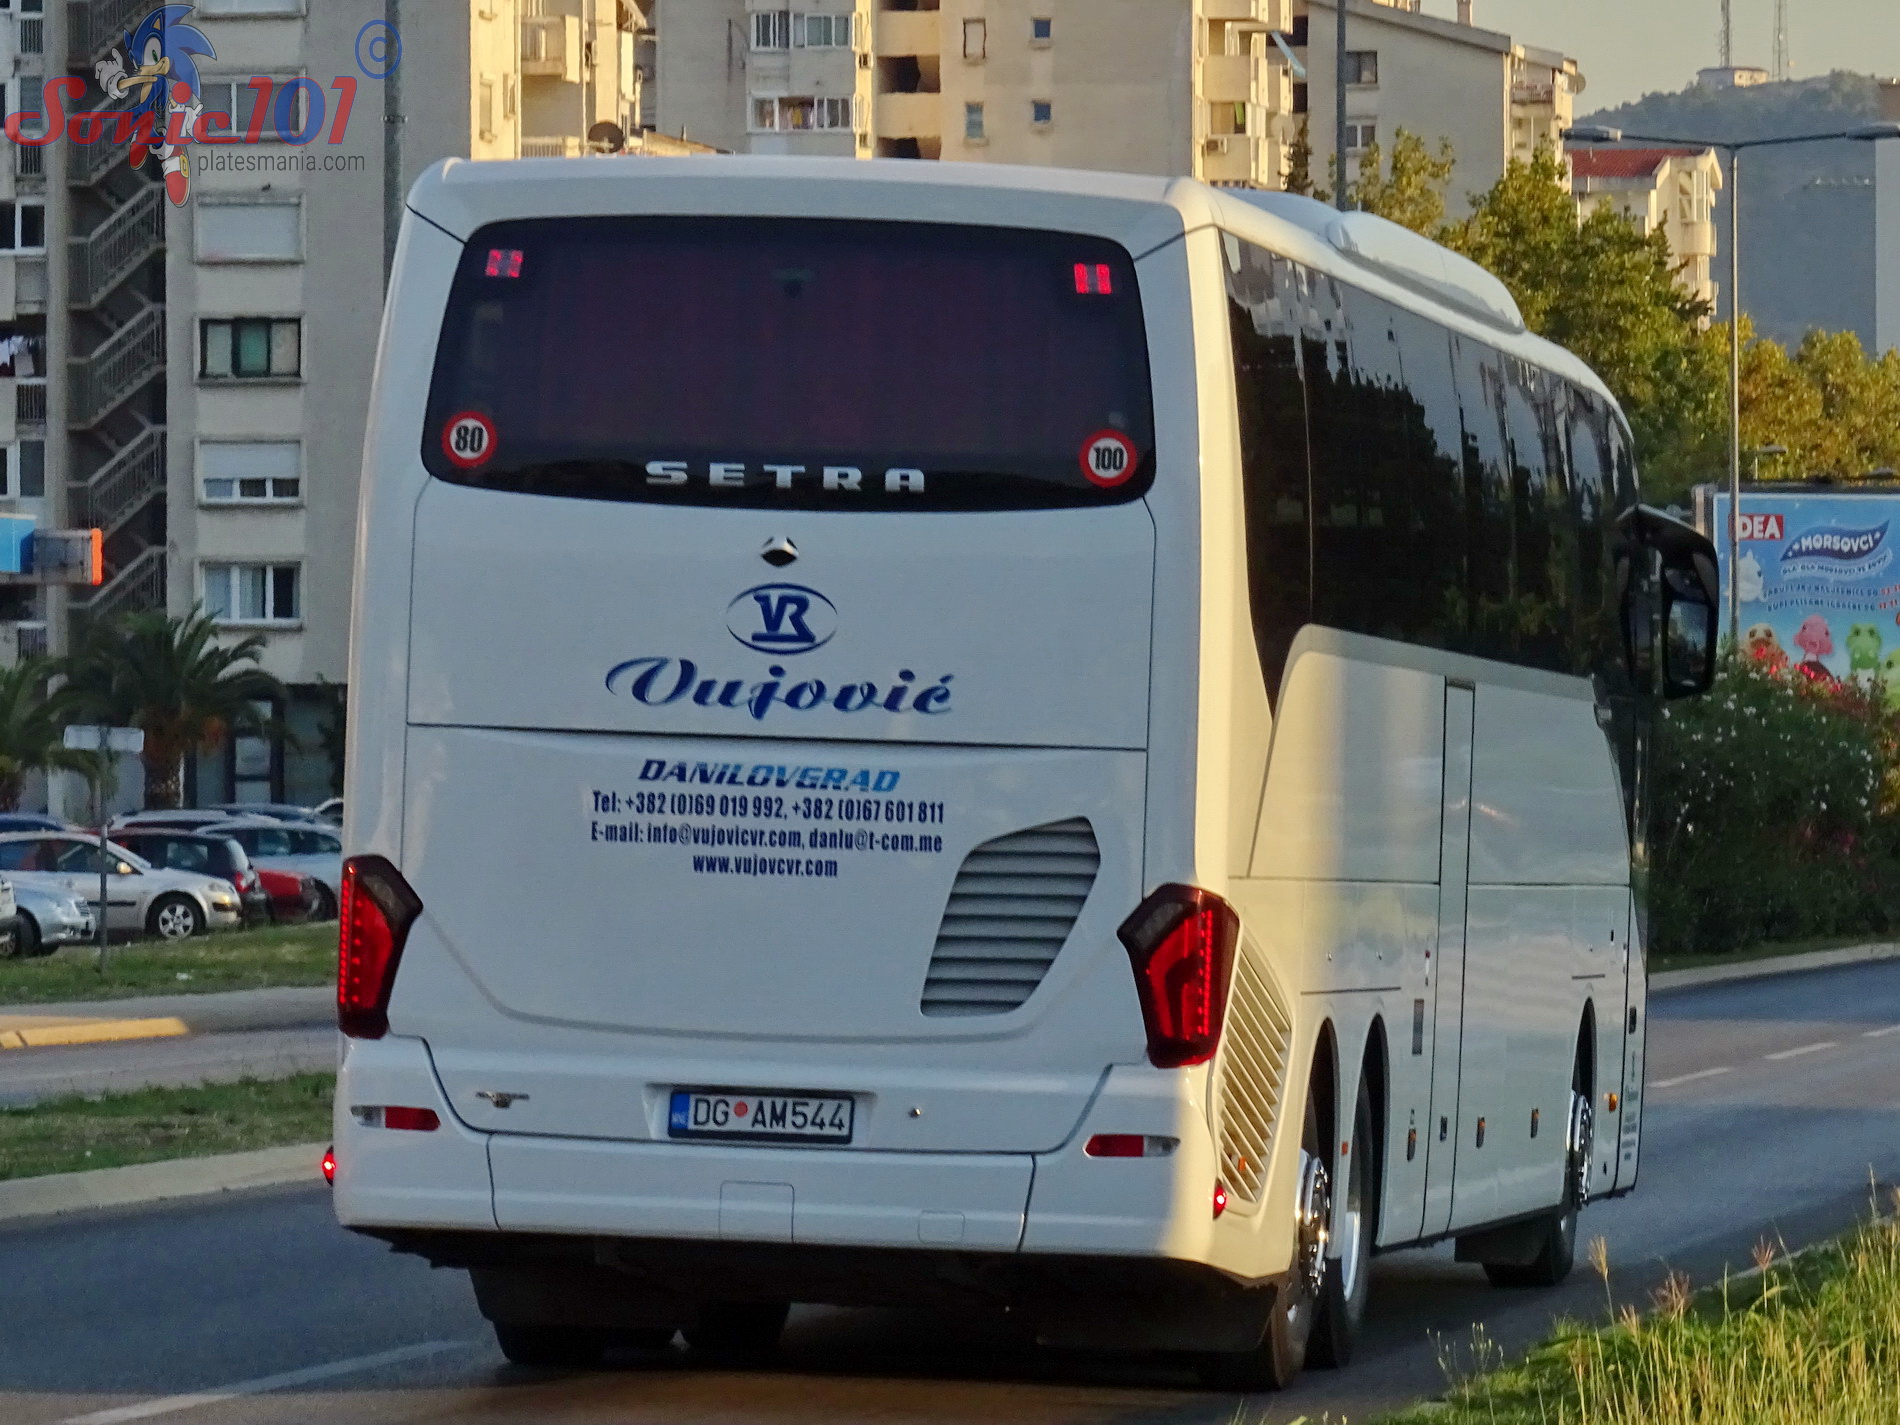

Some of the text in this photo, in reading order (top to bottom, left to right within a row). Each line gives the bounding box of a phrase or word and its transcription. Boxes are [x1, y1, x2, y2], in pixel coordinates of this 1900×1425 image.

[455, 425, 484, 453] 80
[1093, 446, 1124, 471] 100
[645, 460, 926, 493] SETRA
[1737, 514, 1781, 539] DEA
[1801, 533, 1874, 553] MORSOVCI
[605, 656, 954, 721] Vujović
[638, 758, 900, 792] DANILOVGRAD
[592, 789, 945, 824] Tel: +382 (0)69 019 992, +382 (0)67 601 811
[591, 820, 644, 843] E-mail:
[692, 1098, 730, 1127] DG
[751, 1100, 846, 1132] AM544
